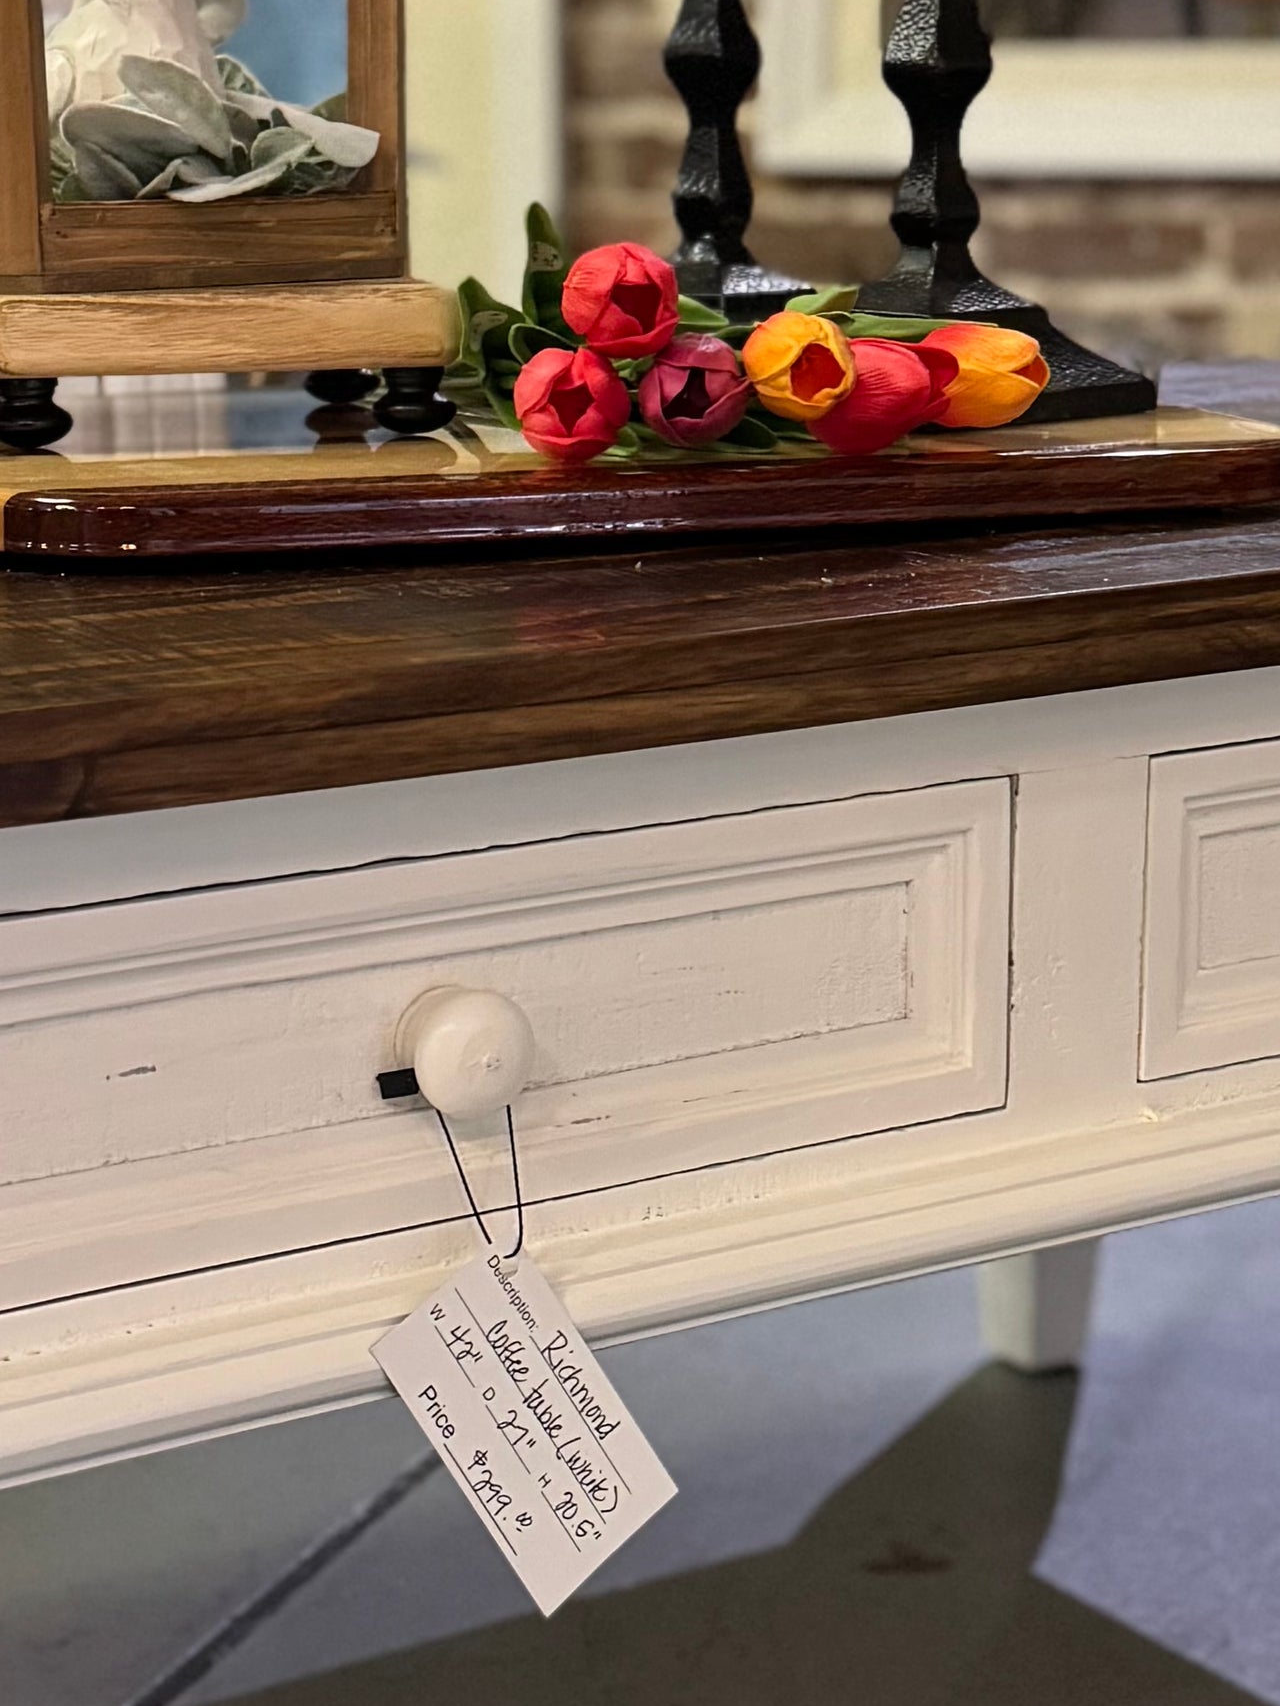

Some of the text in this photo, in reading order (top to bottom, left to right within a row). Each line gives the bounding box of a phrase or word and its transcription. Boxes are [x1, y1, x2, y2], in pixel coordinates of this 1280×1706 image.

[418, 1385, 456, 1440] Price
[429, 1303, 446, 1321] W
[450, 1325, 484, 1364] 42"
[483, 1387, 496, 1402] D
[497, 1410, 536, 1449] 27"
[538, 1472, 552, 1489] H
[523, 1380, 563, 1440] table
[541, 1330, 620, 1441] Richmond
